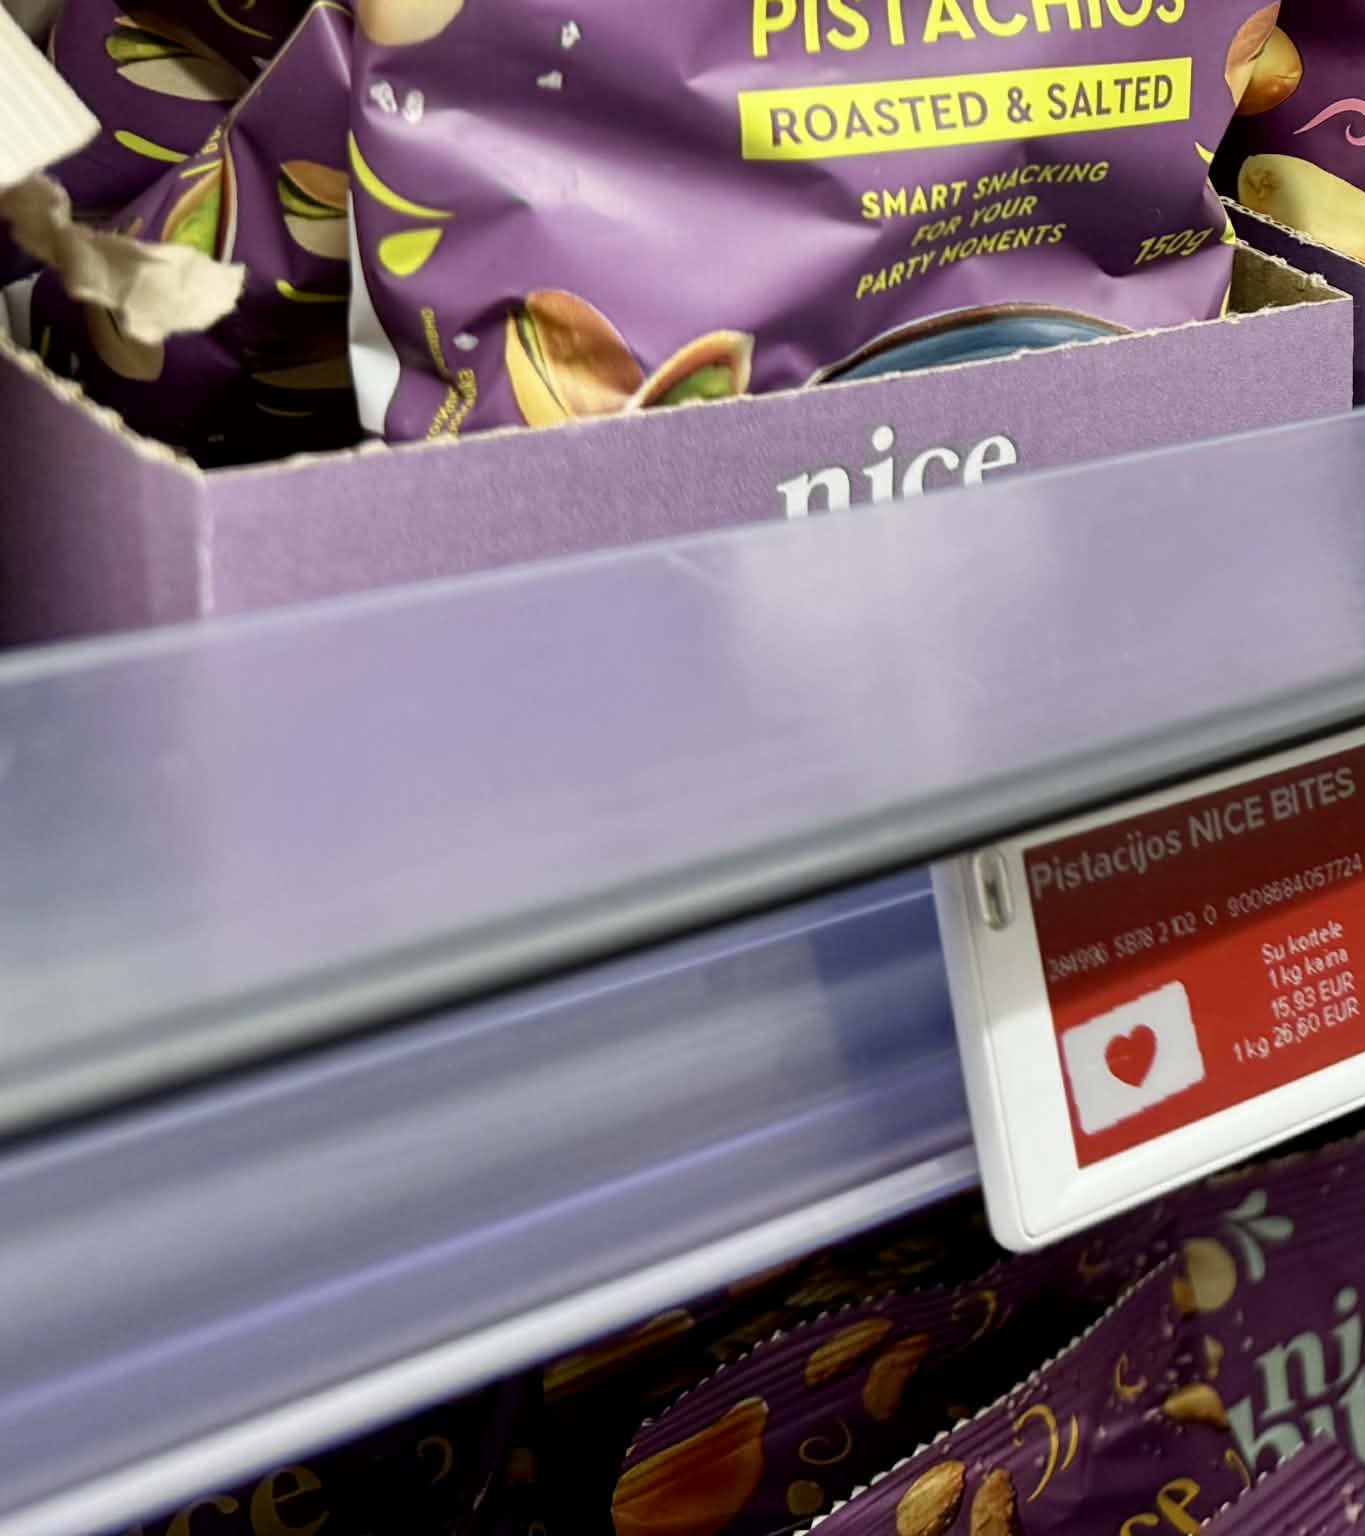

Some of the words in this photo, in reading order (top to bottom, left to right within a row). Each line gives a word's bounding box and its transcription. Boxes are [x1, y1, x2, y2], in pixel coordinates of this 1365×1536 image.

[769, 90, 989, 148] ROASTED
[1006, 85, 1033, 124] &
[1046, 73, 1174, 122] SALTED
[861, 180, 968, 220] SMART
[973, 160, 1110, 200] SNACKING
[911, 207, 962, 248] FOR
[968, 195, 1038, 230] YOUR
[1133, 226, 1216, 266] 150g
[855, 251, 937, 300] PARTY
[938, 223, 1066, 268] MOMENTS
[776, 425, 1018, 520] nice
[1030, 830, 1183, 901] Pistacijos
[1188, 797, 1265, 850] NICE
[1270, 766, 1357, 823] BITES
[1261, 943, 1285, 965] Su
[1280, 962, 1303, 985] kg
[1304, 948, 1350, 976] kaina
[1271, 986, 1317, 1020] 15,93
[1318, 970, 1356, 1002] EUR
[1232, 1042, 1244, 1063] 1
[1244, 1036, 1270, 1060] kg
[1322, 995, 1361, 1029] EUR
